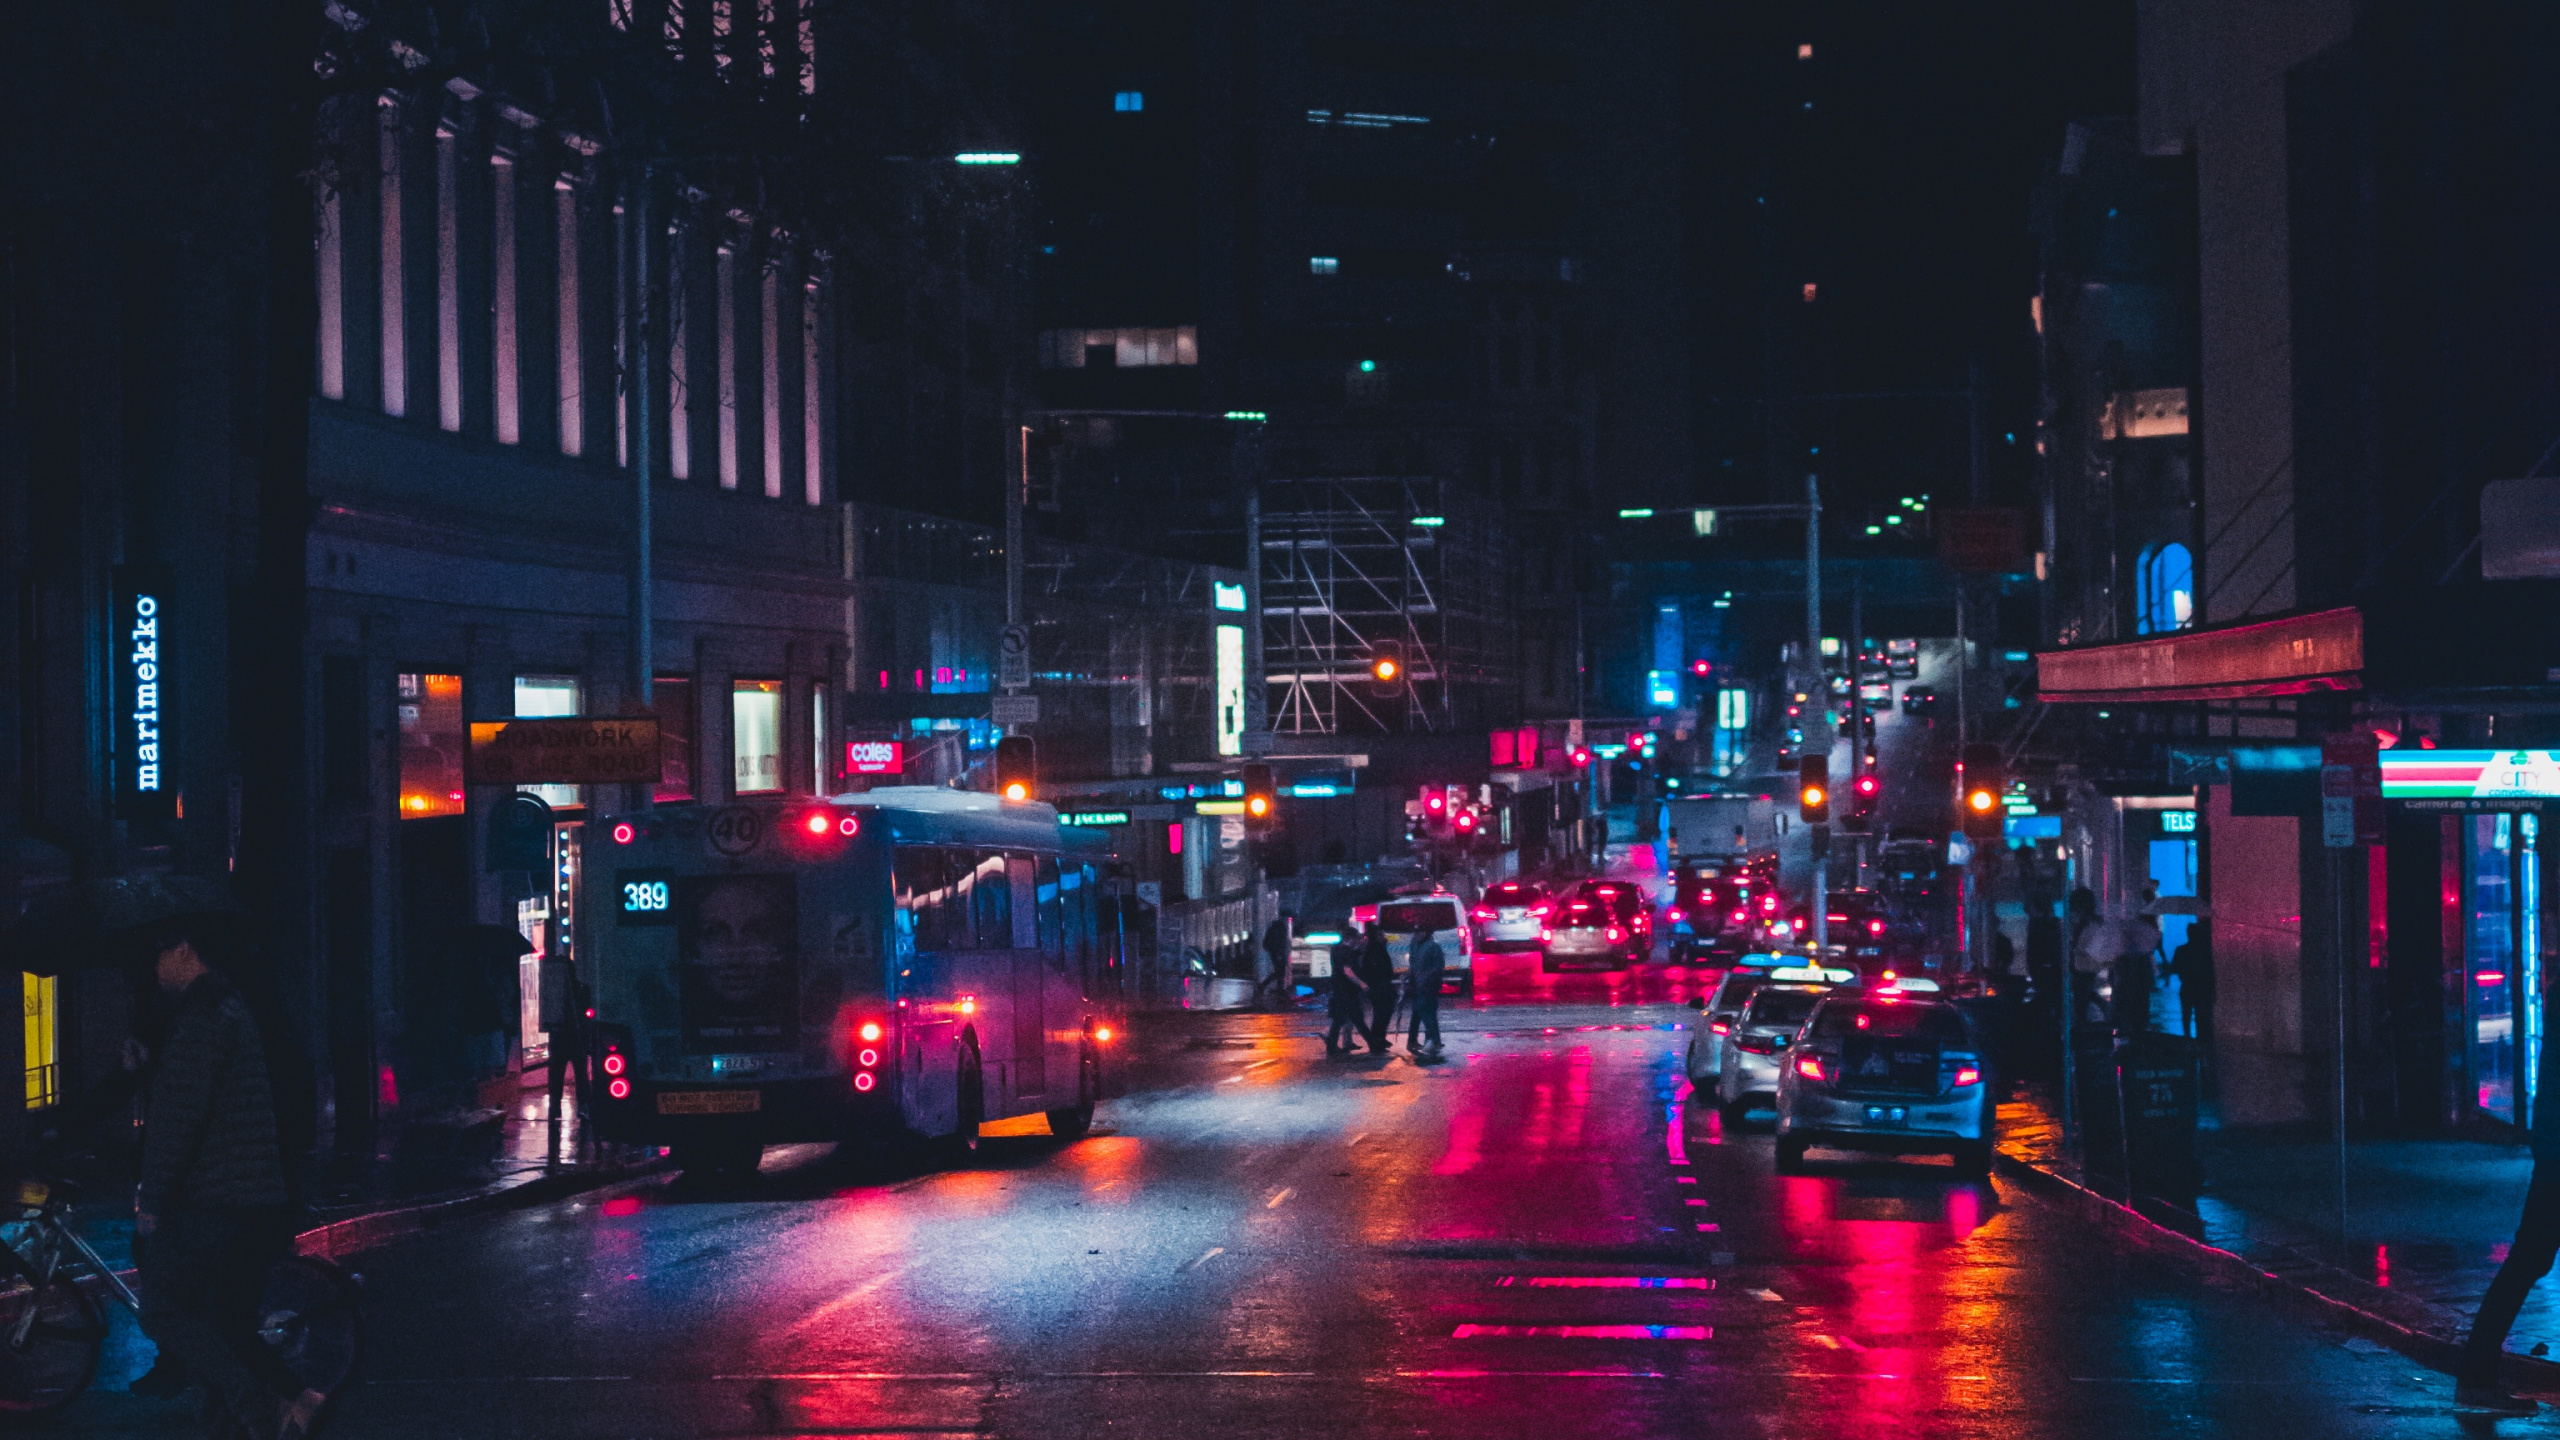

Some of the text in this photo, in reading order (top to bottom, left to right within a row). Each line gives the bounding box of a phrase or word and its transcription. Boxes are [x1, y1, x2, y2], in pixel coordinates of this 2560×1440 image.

[131, 594, 160, 792] marimekko
[495, 728, 634, 748] ROADWORK
[851, 742, 893, 763] coles
[2500, 770, 2541, 787] CITY
[2405, 800, 2467, 810] cameras
[715, 816, 756, 842] 40
[1074, 813, 1127, 826] JACKSON
[2161, 811, 2198, 832] TELS
[623, 881, 670, 912] 389
